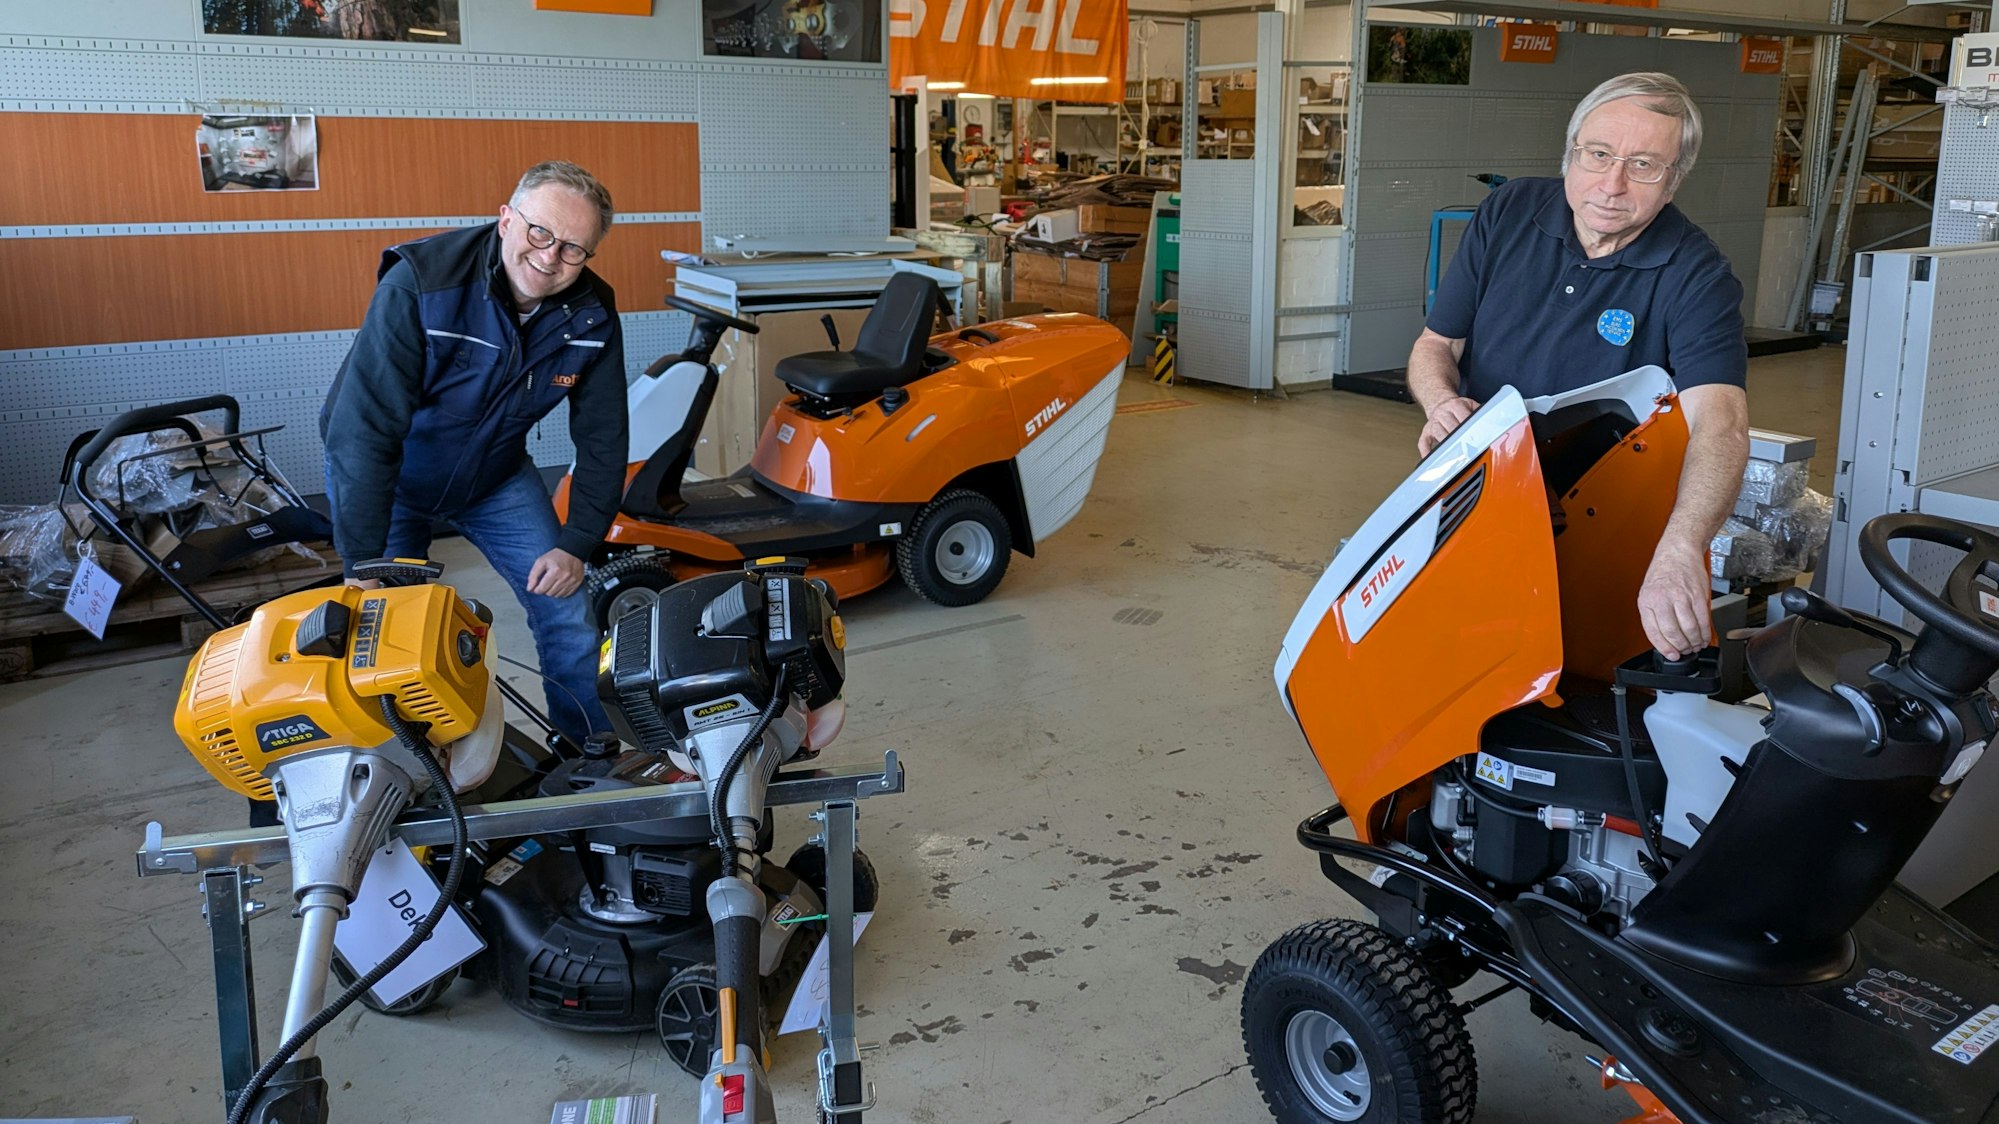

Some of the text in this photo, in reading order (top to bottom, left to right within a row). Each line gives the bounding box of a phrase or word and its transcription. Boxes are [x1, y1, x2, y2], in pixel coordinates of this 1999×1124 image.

[1512, 35, 1553, 51] STIHL
[1749, 50, 1779, 65] STIHL
[1025, 397, 1067, 437] STIHL
[1361, 554, 1405, 608] STIHL
[698, 702, 736, 717] ALPINA
[262, 722, 314, 742] STIGA
[271, 738, 289, 747] SBC
[289, 734, 306, 743] 232
